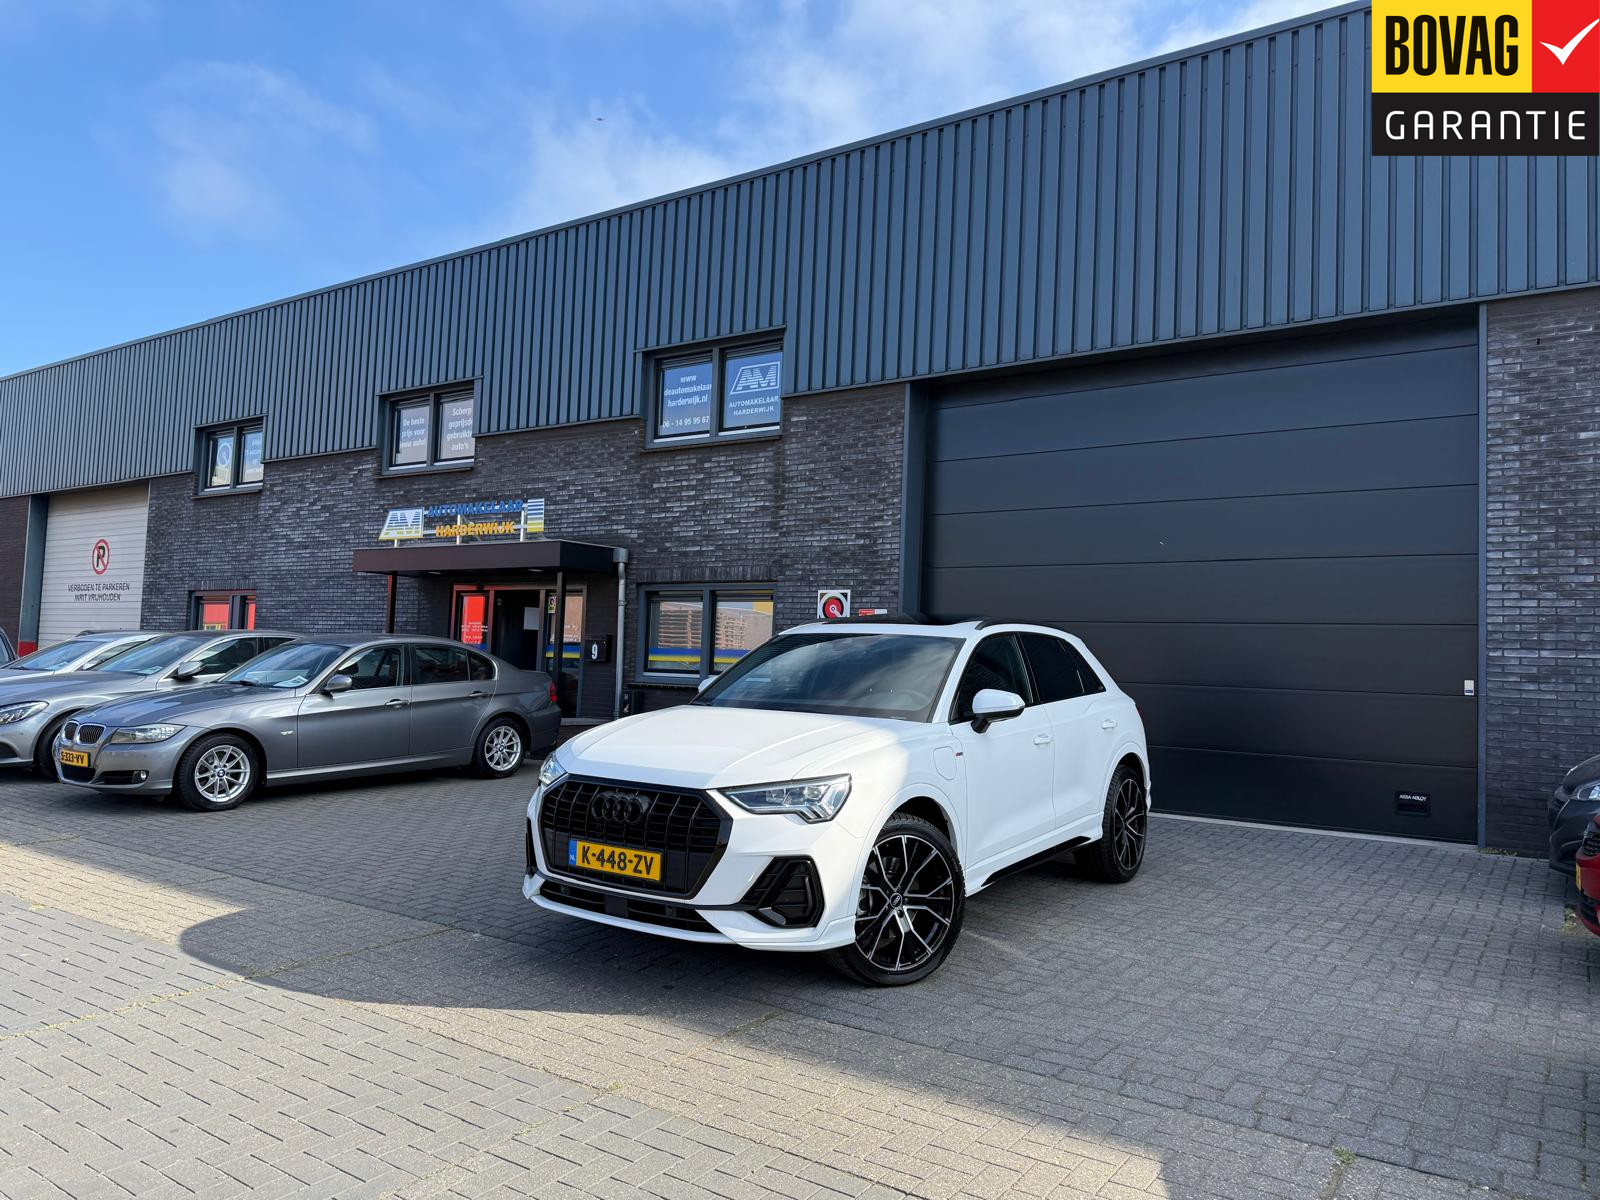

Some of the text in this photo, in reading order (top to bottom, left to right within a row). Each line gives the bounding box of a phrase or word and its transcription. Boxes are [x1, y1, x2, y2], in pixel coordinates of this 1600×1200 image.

[680, 375, 697, 383] www
[667, 394, 708, 407] harderwijk.nl
[728, 395, 779, 408] AUTOMAKELAAR
[452, 408, 472, 416] Scherp
[733, 406, 775, 417] HARDERWIJK
[676, 419, 683, 427] 14
[684, 417, 692, 426] 95
[692, 416, 701, 425] 95
[701, 415, 710, 424] 67
[401, 428, 426, 439] prijs voor
[452, 442, 469, 450] auto's
[427, 499, 524, 518] AUTOMAKELAAR
[435, 520, 516, 538] HARDERWIJK
[68, 582, 130, 592] VERBODEN TE PARKEREN
[591, 643, 598, 660] 9
[61, 751, 85, 764] S-333-VV
[581, 844, 654, 876] K-448-ZV
